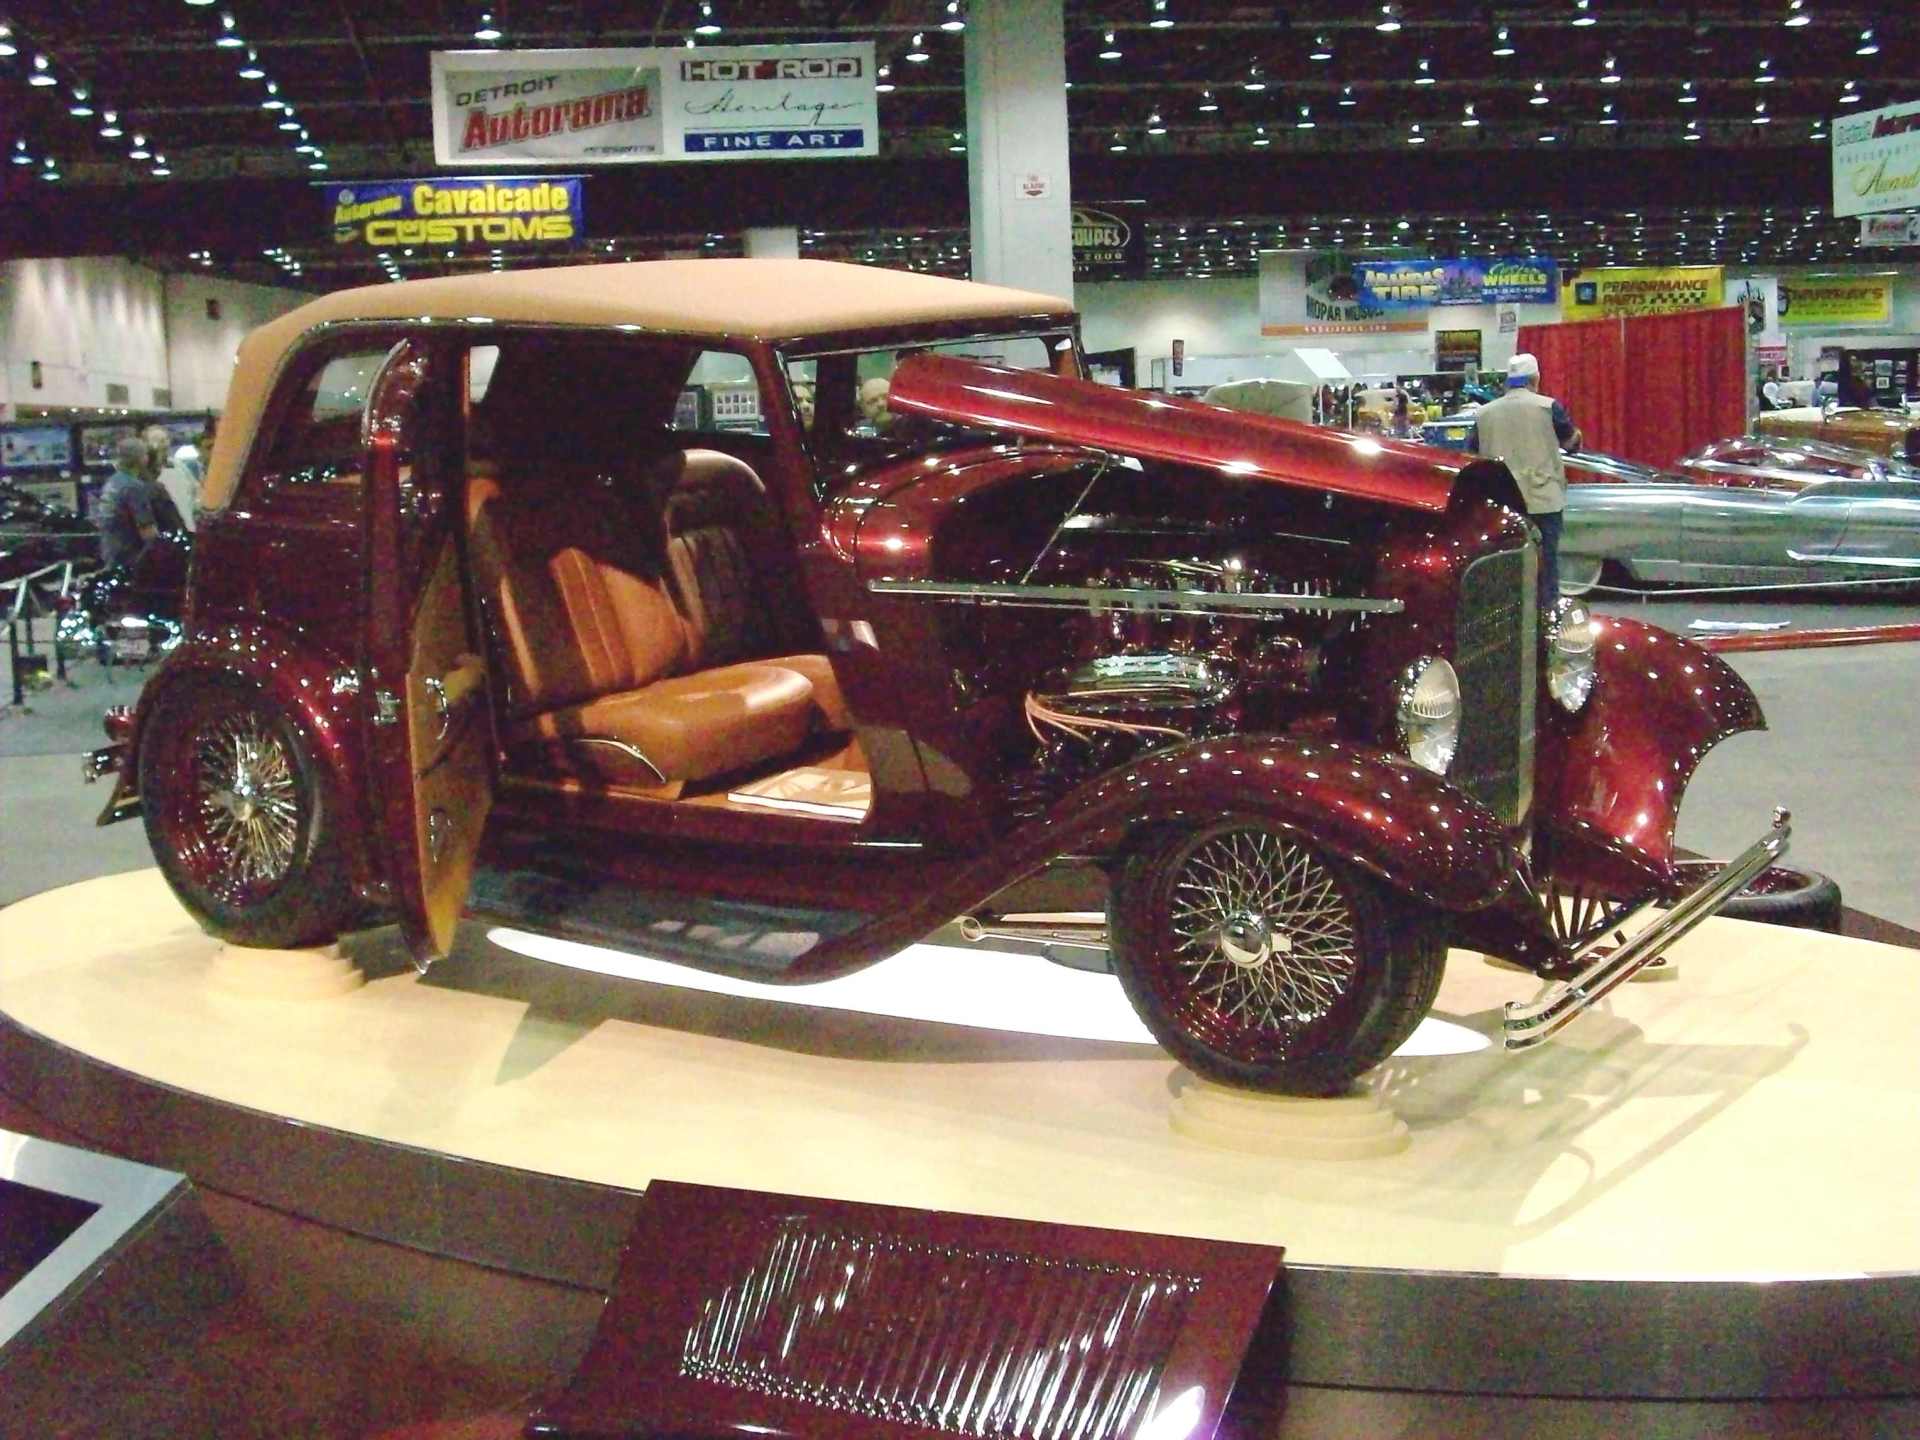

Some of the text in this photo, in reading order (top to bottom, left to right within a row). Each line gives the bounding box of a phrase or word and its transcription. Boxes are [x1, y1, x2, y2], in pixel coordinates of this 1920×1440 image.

[685, 58, 858, 81] HOT ROD
[459, 84, 652, 152] Autorama
[684, 88, 864, 126] Heritage
[703, 133, 845, 148] FINE ART
[413, 182, 570, 215] Cavalcade
[366, 215, 575, 246] CUSTOMS
[1483, 273, 1548, 287] WHEELS
[1603, 279, 1709, 293] PERFORMANCE
[1306, 294, 1342, 321] MOPAR
[1603, 294, 1646, 305] PARTS
